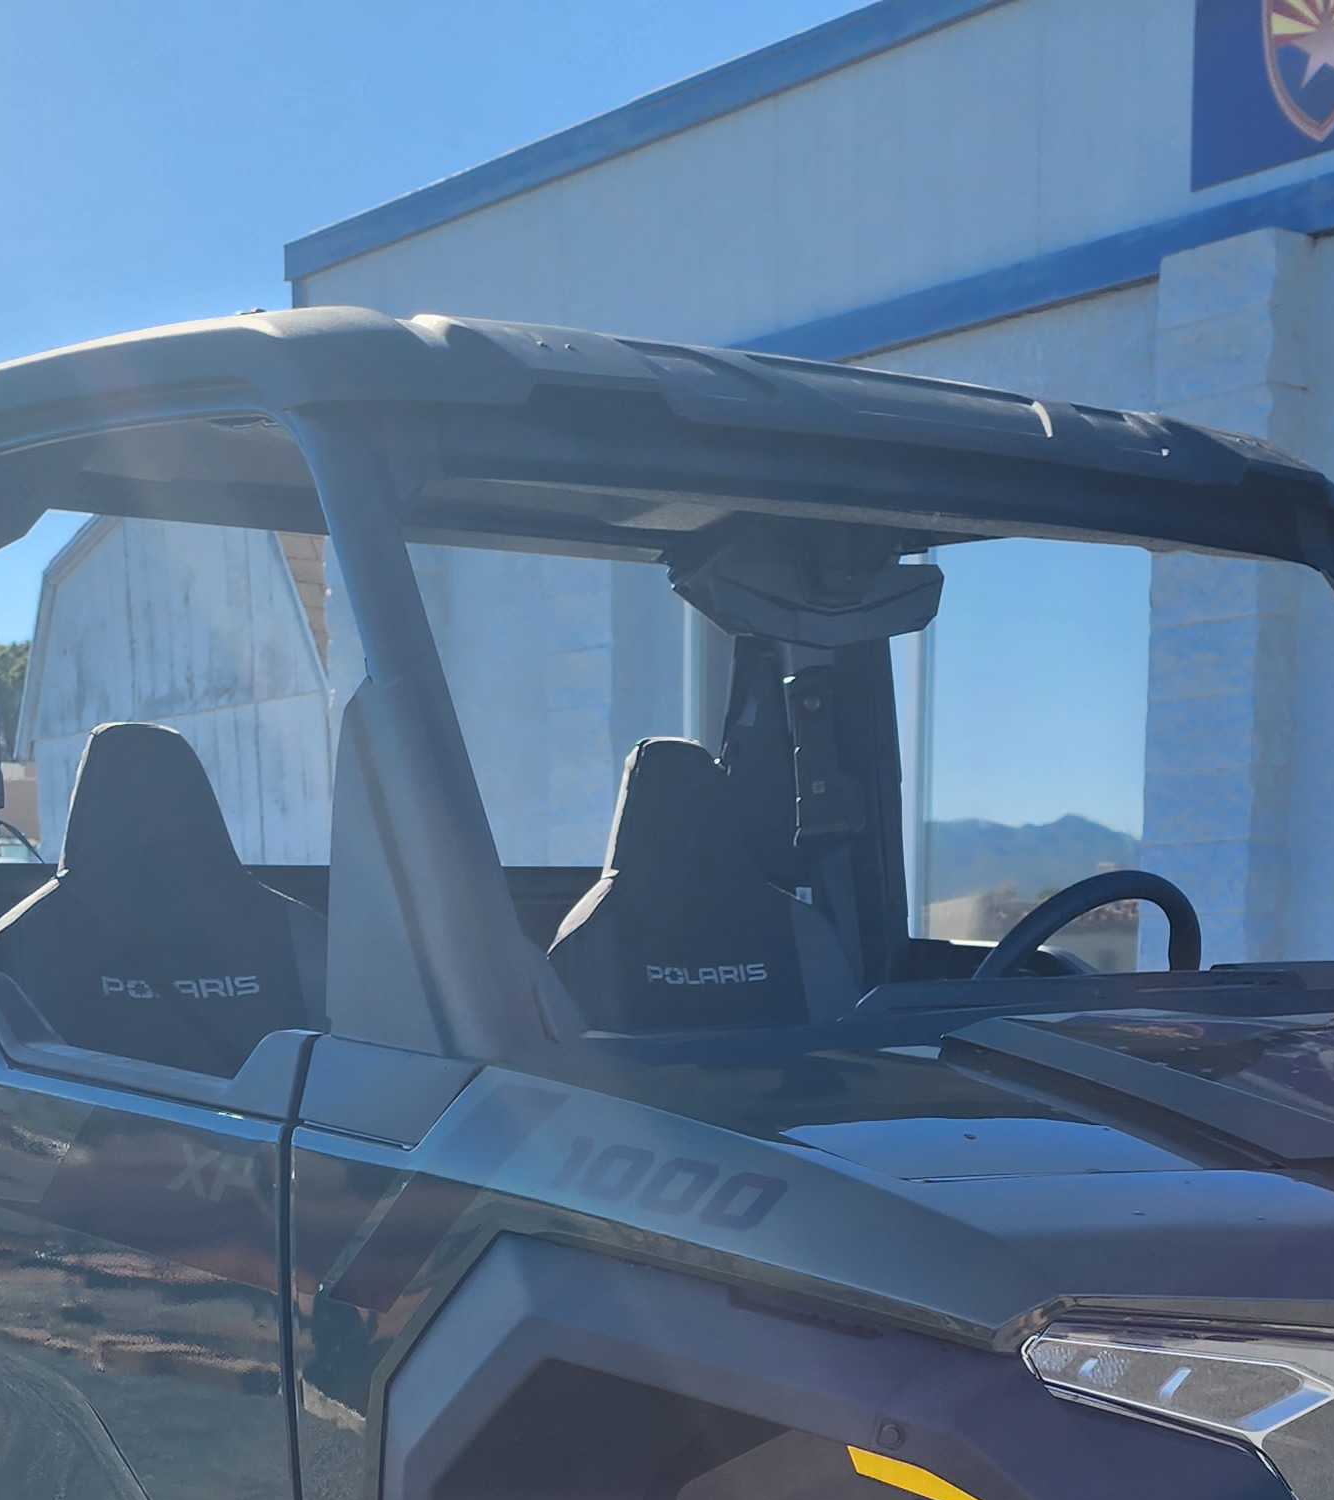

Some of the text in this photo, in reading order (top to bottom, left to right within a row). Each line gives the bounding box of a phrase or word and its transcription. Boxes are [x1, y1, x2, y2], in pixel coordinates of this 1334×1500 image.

[101, 974, 260, 999] POARIS
[646, 962, 768, 985] POLARIS
[164, 1143, 254, 1202] XP
[548, 1135, 788, 1233] 1000
